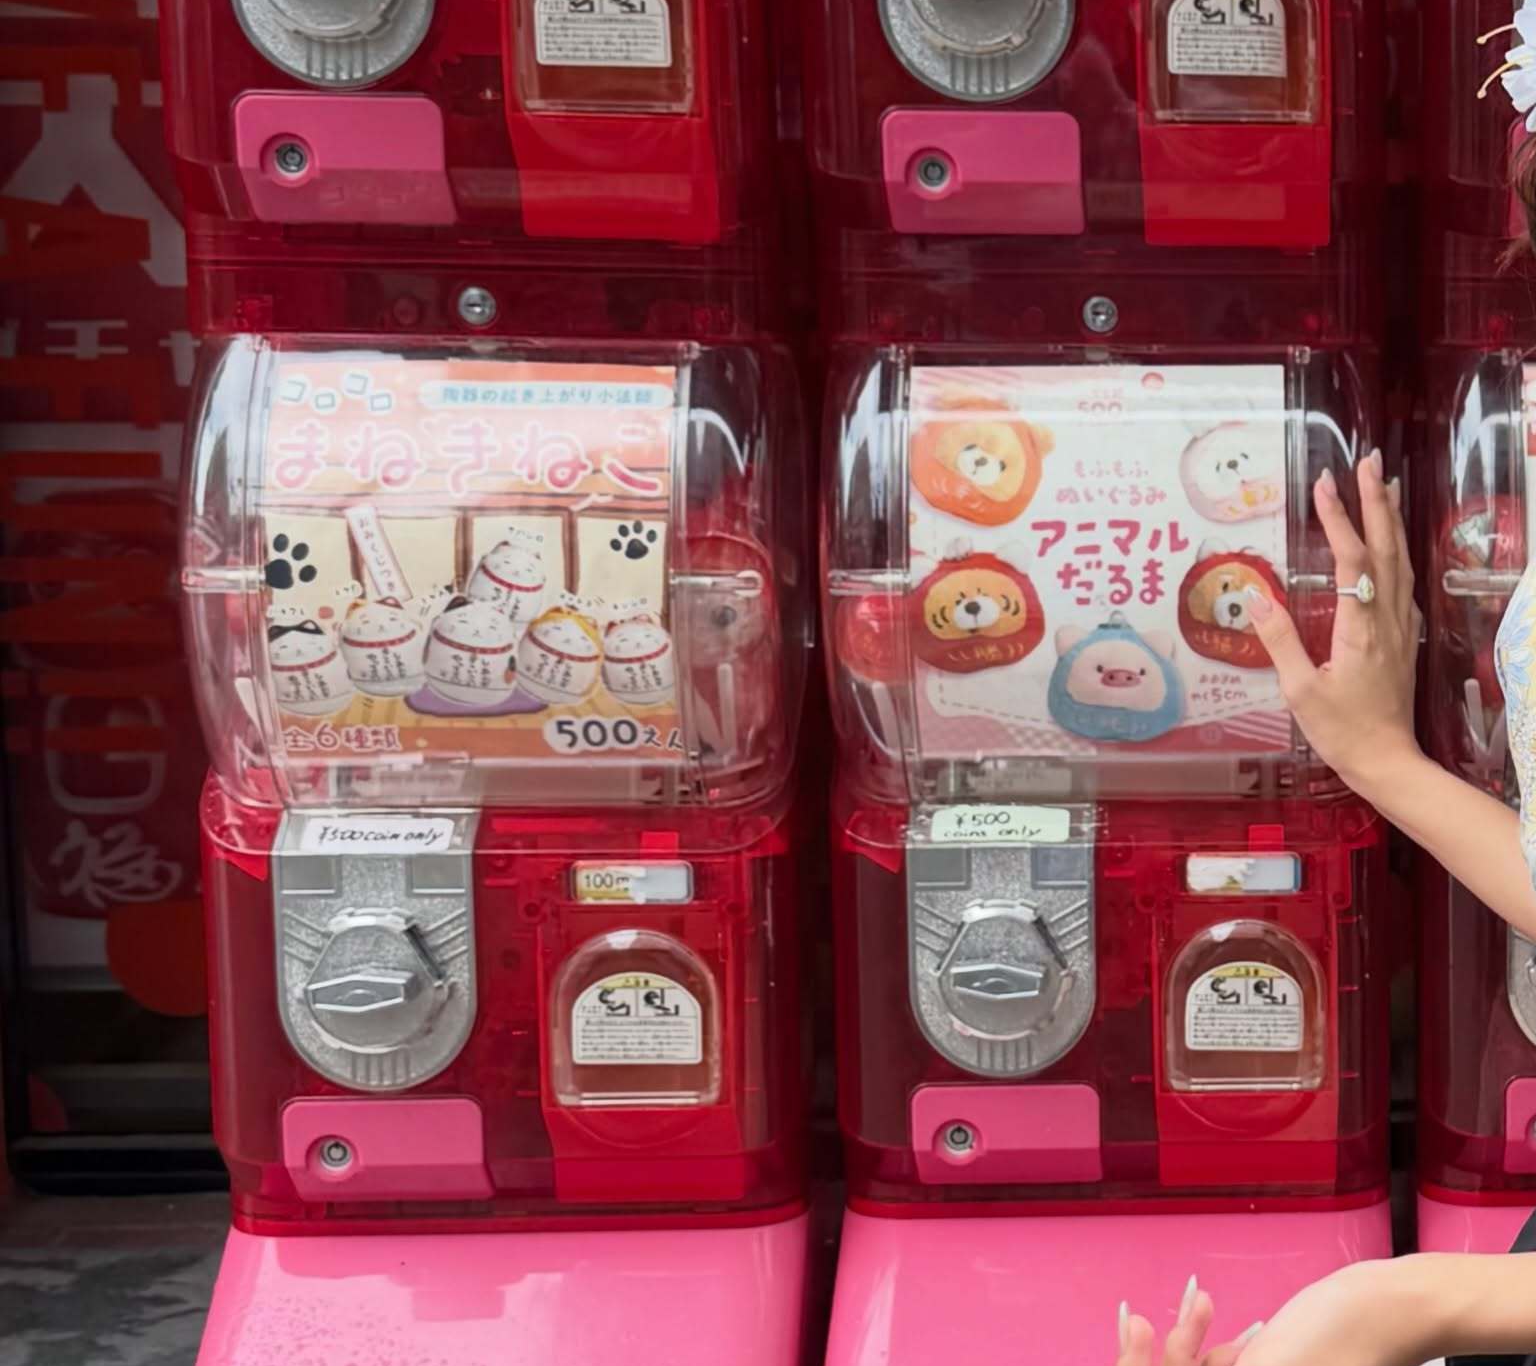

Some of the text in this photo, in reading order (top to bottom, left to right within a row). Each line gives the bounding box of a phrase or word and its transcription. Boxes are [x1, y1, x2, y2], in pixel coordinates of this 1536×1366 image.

[272, 419, 664, 497] まねきねこ
[1030, 518, 1190, 558] アニマル
[1056, 558, 1166, 608] だるま
